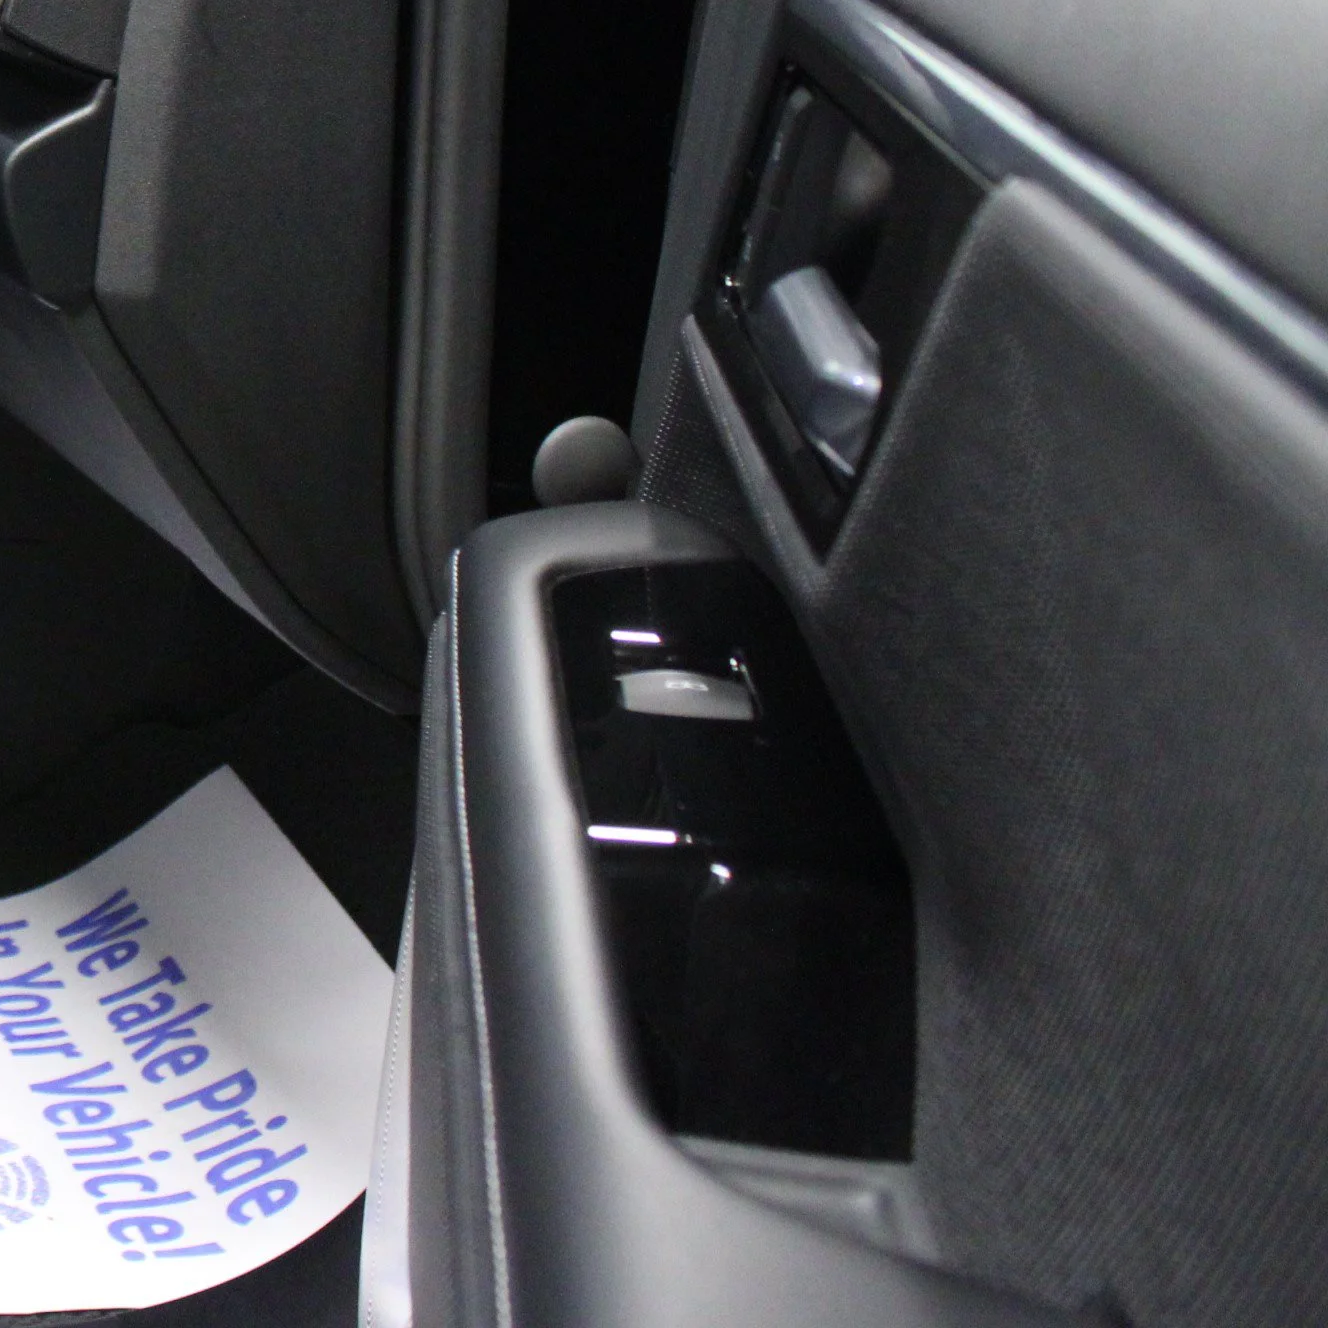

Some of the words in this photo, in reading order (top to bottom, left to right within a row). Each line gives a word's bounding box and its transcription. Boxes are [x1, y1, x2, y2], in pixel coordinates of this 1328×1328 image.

[55, 886, 150, 978] We
[98, 955, 214, 1084] Take
[28, 1061, 227, 1263] Vehicle!
[162, 1068, 308, 1226] Pride
